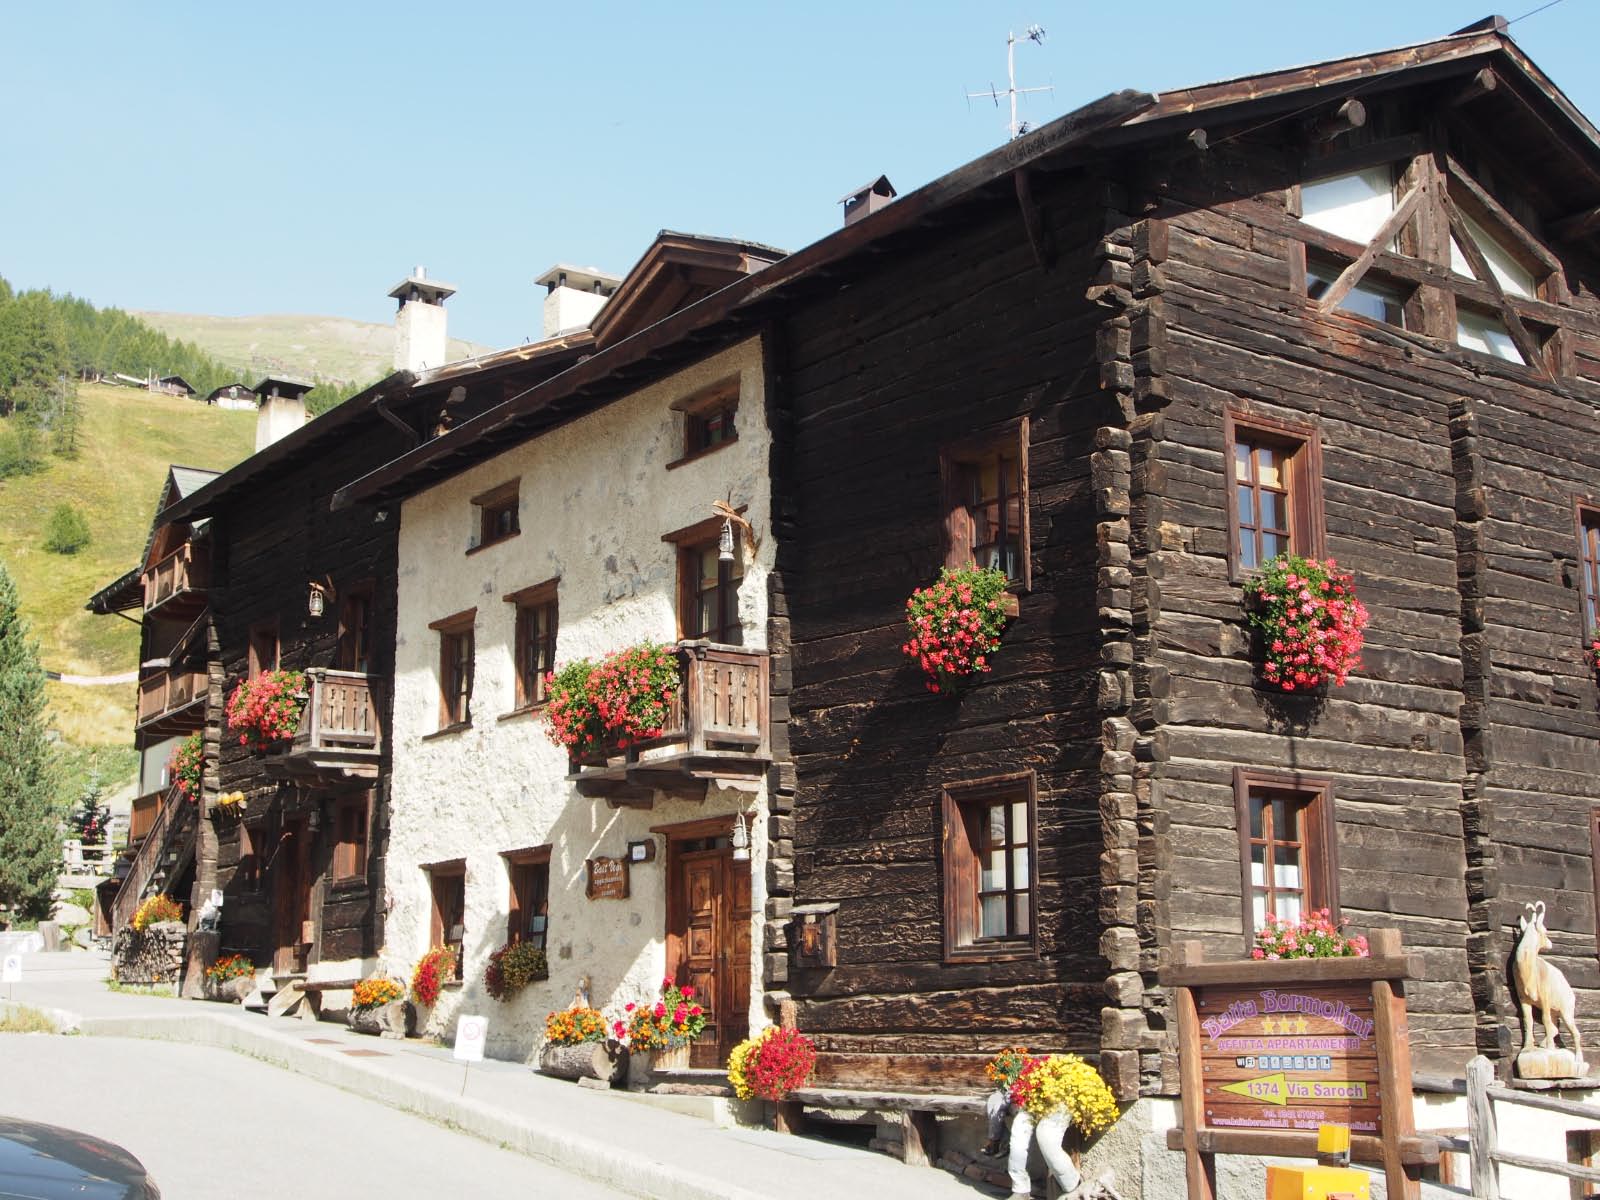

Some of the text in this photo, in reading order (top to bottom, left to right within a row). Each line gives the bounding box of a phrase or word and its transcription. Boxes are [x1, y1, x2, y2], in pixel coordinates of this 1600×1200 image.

[1201, 989, 1374, 1040] Baita Bormolini
[1218, 1038, 1360, 1050] AFFITTA APPARTAMENTI
[1247, 1083, 1363, 1097] 1374 Via Saroch
